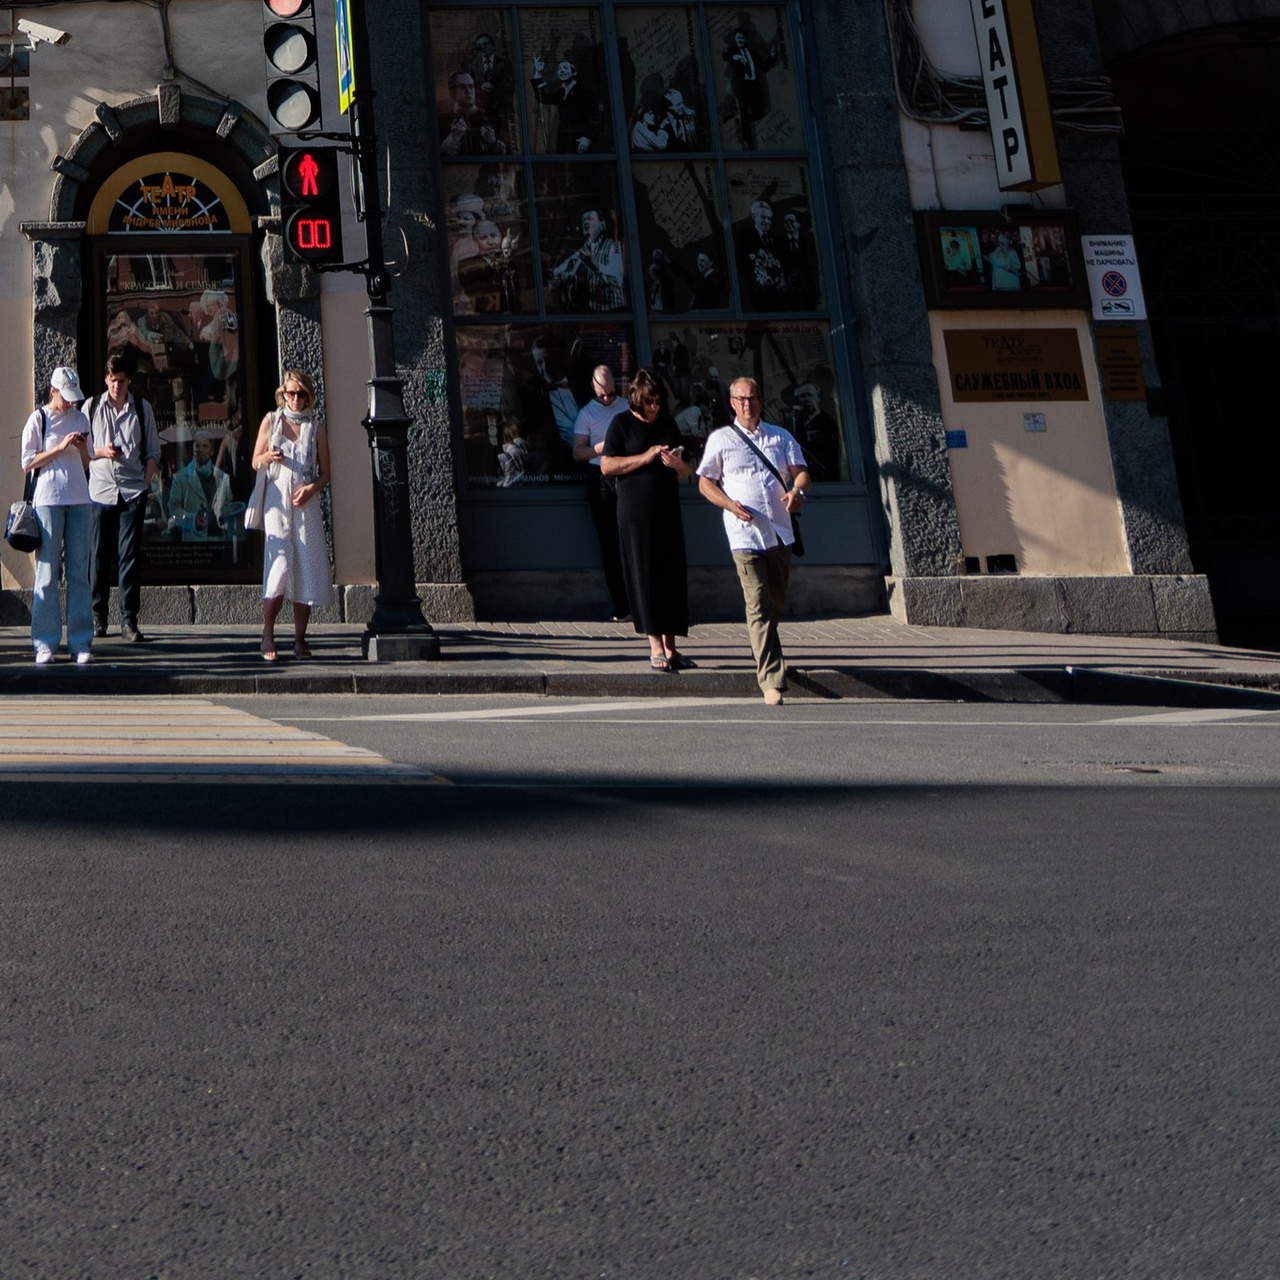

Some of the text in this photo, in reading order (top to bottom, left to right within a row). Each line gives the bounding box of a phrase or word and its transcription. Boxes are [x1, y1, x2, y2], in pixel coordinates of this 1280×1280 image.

[139, 174, 197, 204] ТЕАТР
[152, 206, 189, 216] ИМЕНИ
[122, 214, 219, 229] АНДРЕЯ МИРОНОВА
[955, 369, 1082, 391] СЛУЖЕБНЫЙ ВХОД
